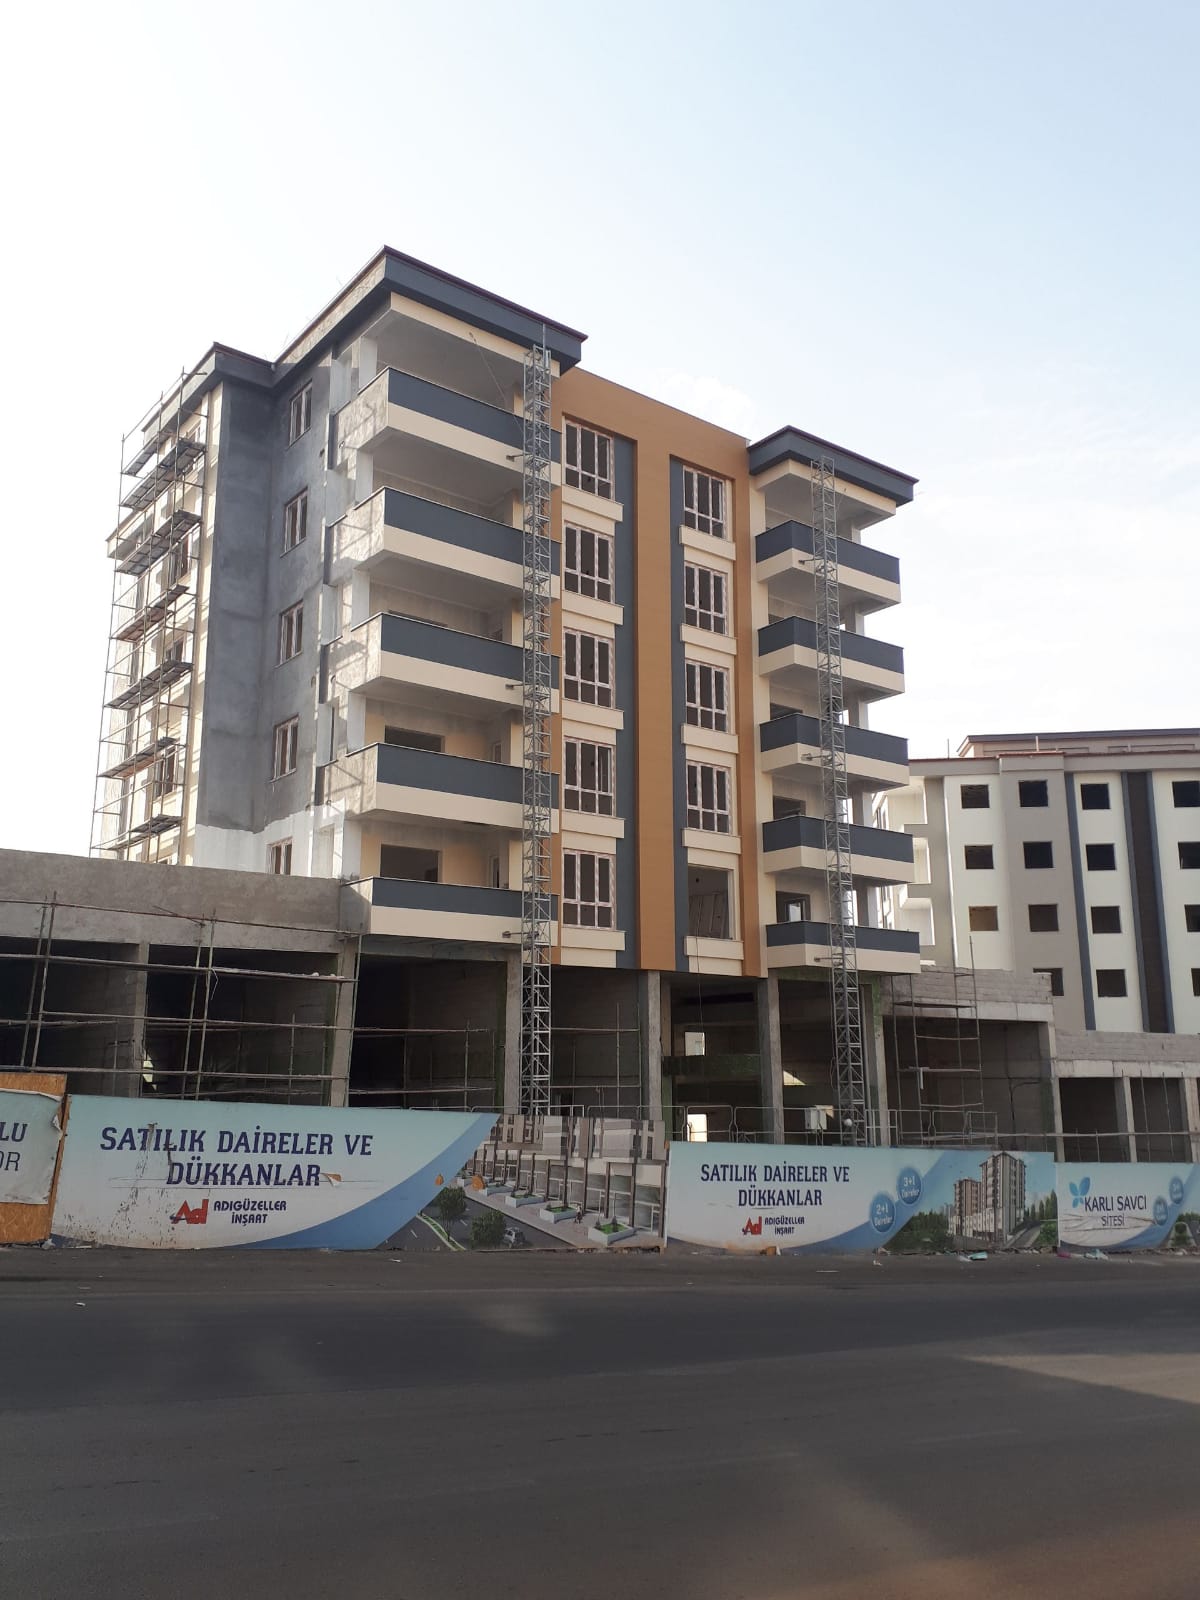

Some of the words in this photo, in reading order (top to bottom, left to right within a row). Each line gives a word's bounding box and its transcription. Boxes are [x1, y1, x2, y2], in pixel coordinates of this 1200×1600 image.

[100, 1127, 206, 1152] SATILIK
[217, 1126, 333, 1155] DAİRELER
[345, 1134, 373, 1156] VE
[0, 1151, 21, 1171] R
[166, 1156, 321, 1186] DÜKKANLAR
[701, 1164, 757, 1182] SATILIK
[764, 1161, 827, 1182] DAİRELER
[834, 1166, 850, 1182] VE
[738, 1185, 823, 1206] DÜKKANLAR
[1084, 1196, 1114, 1212] KARLI
[1117, 1195, 1147, 1210] SAVCI
[1101, 1213, 1125, 1227] SİTESİ
